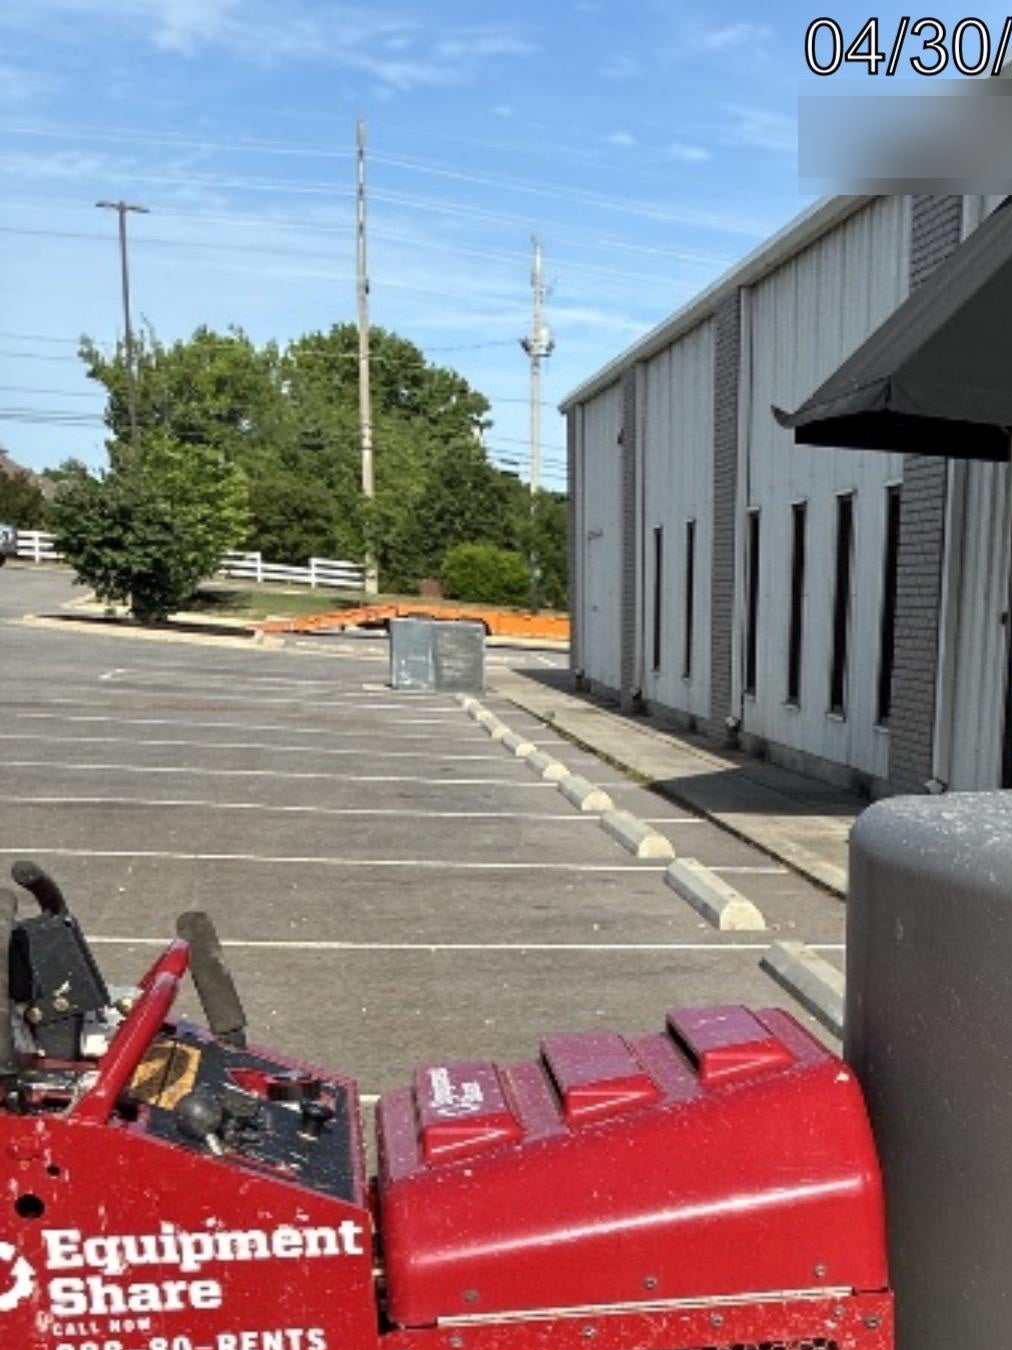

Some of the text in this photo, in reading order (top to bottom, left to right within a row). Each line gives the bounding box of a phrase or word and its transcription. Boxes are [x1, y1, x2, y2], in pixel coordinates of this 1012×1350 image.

[41, 1220, 364, 1275] Equipment
[48, 1276, 223, 1317] Share
[53, 1317, 151, 1336] CALL NOW
